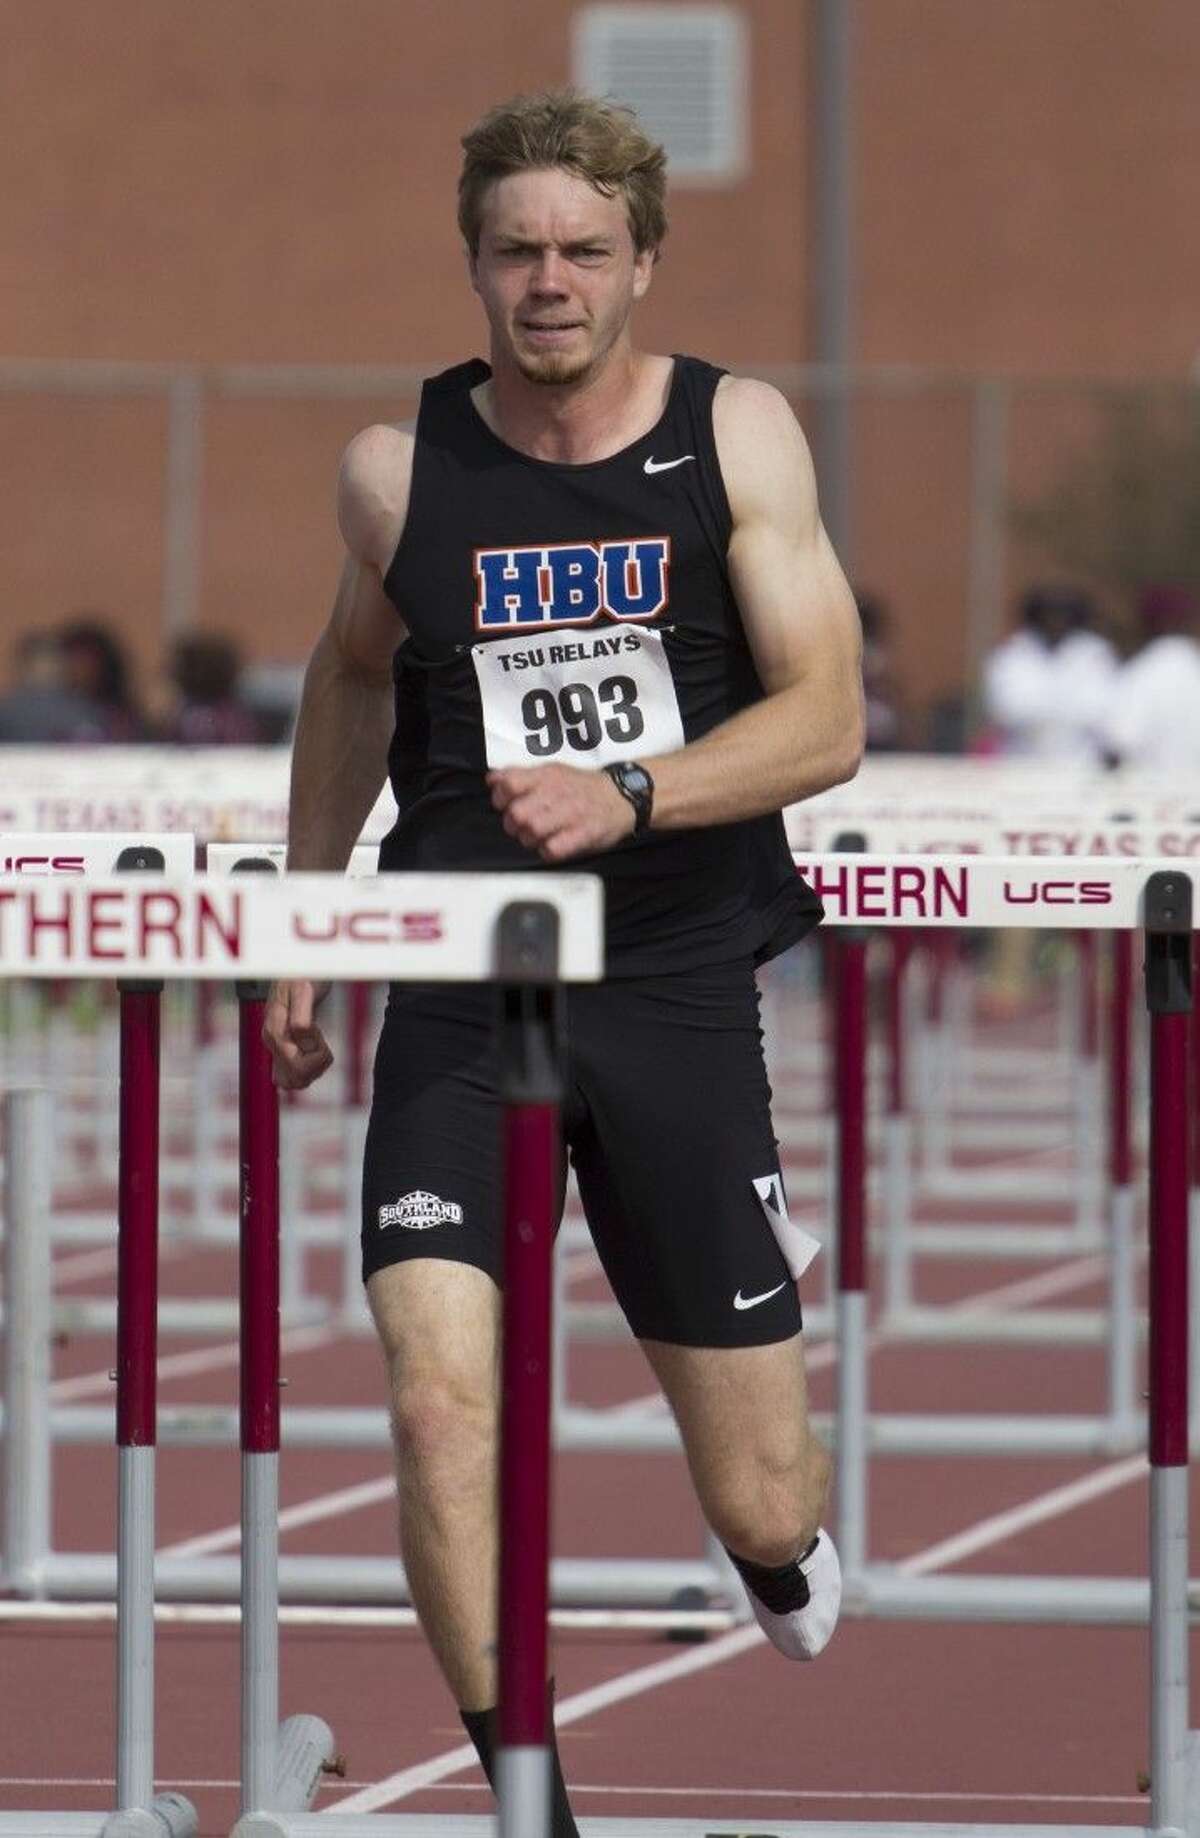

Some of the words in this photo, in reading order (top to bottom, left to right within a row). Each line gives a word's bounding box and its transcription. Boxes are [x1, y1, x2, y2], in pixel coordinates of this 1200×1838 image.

[475, 537, 670, 631] HBU
[498, 648, 545, 672] TSU
[550, 634, 641, 664] RELAYS
[521, 675, 644, 756] 993
[1001, 831, 1142, 856] TEXAS
[4, 856, 85, 875] CS
[796, 866, 968, 917] HERN
[1004, 882, 1112, 904] UCS
[291, 909, 443, 942] UCS
[379, 1202, 463, 1228] SOUTHLAND
